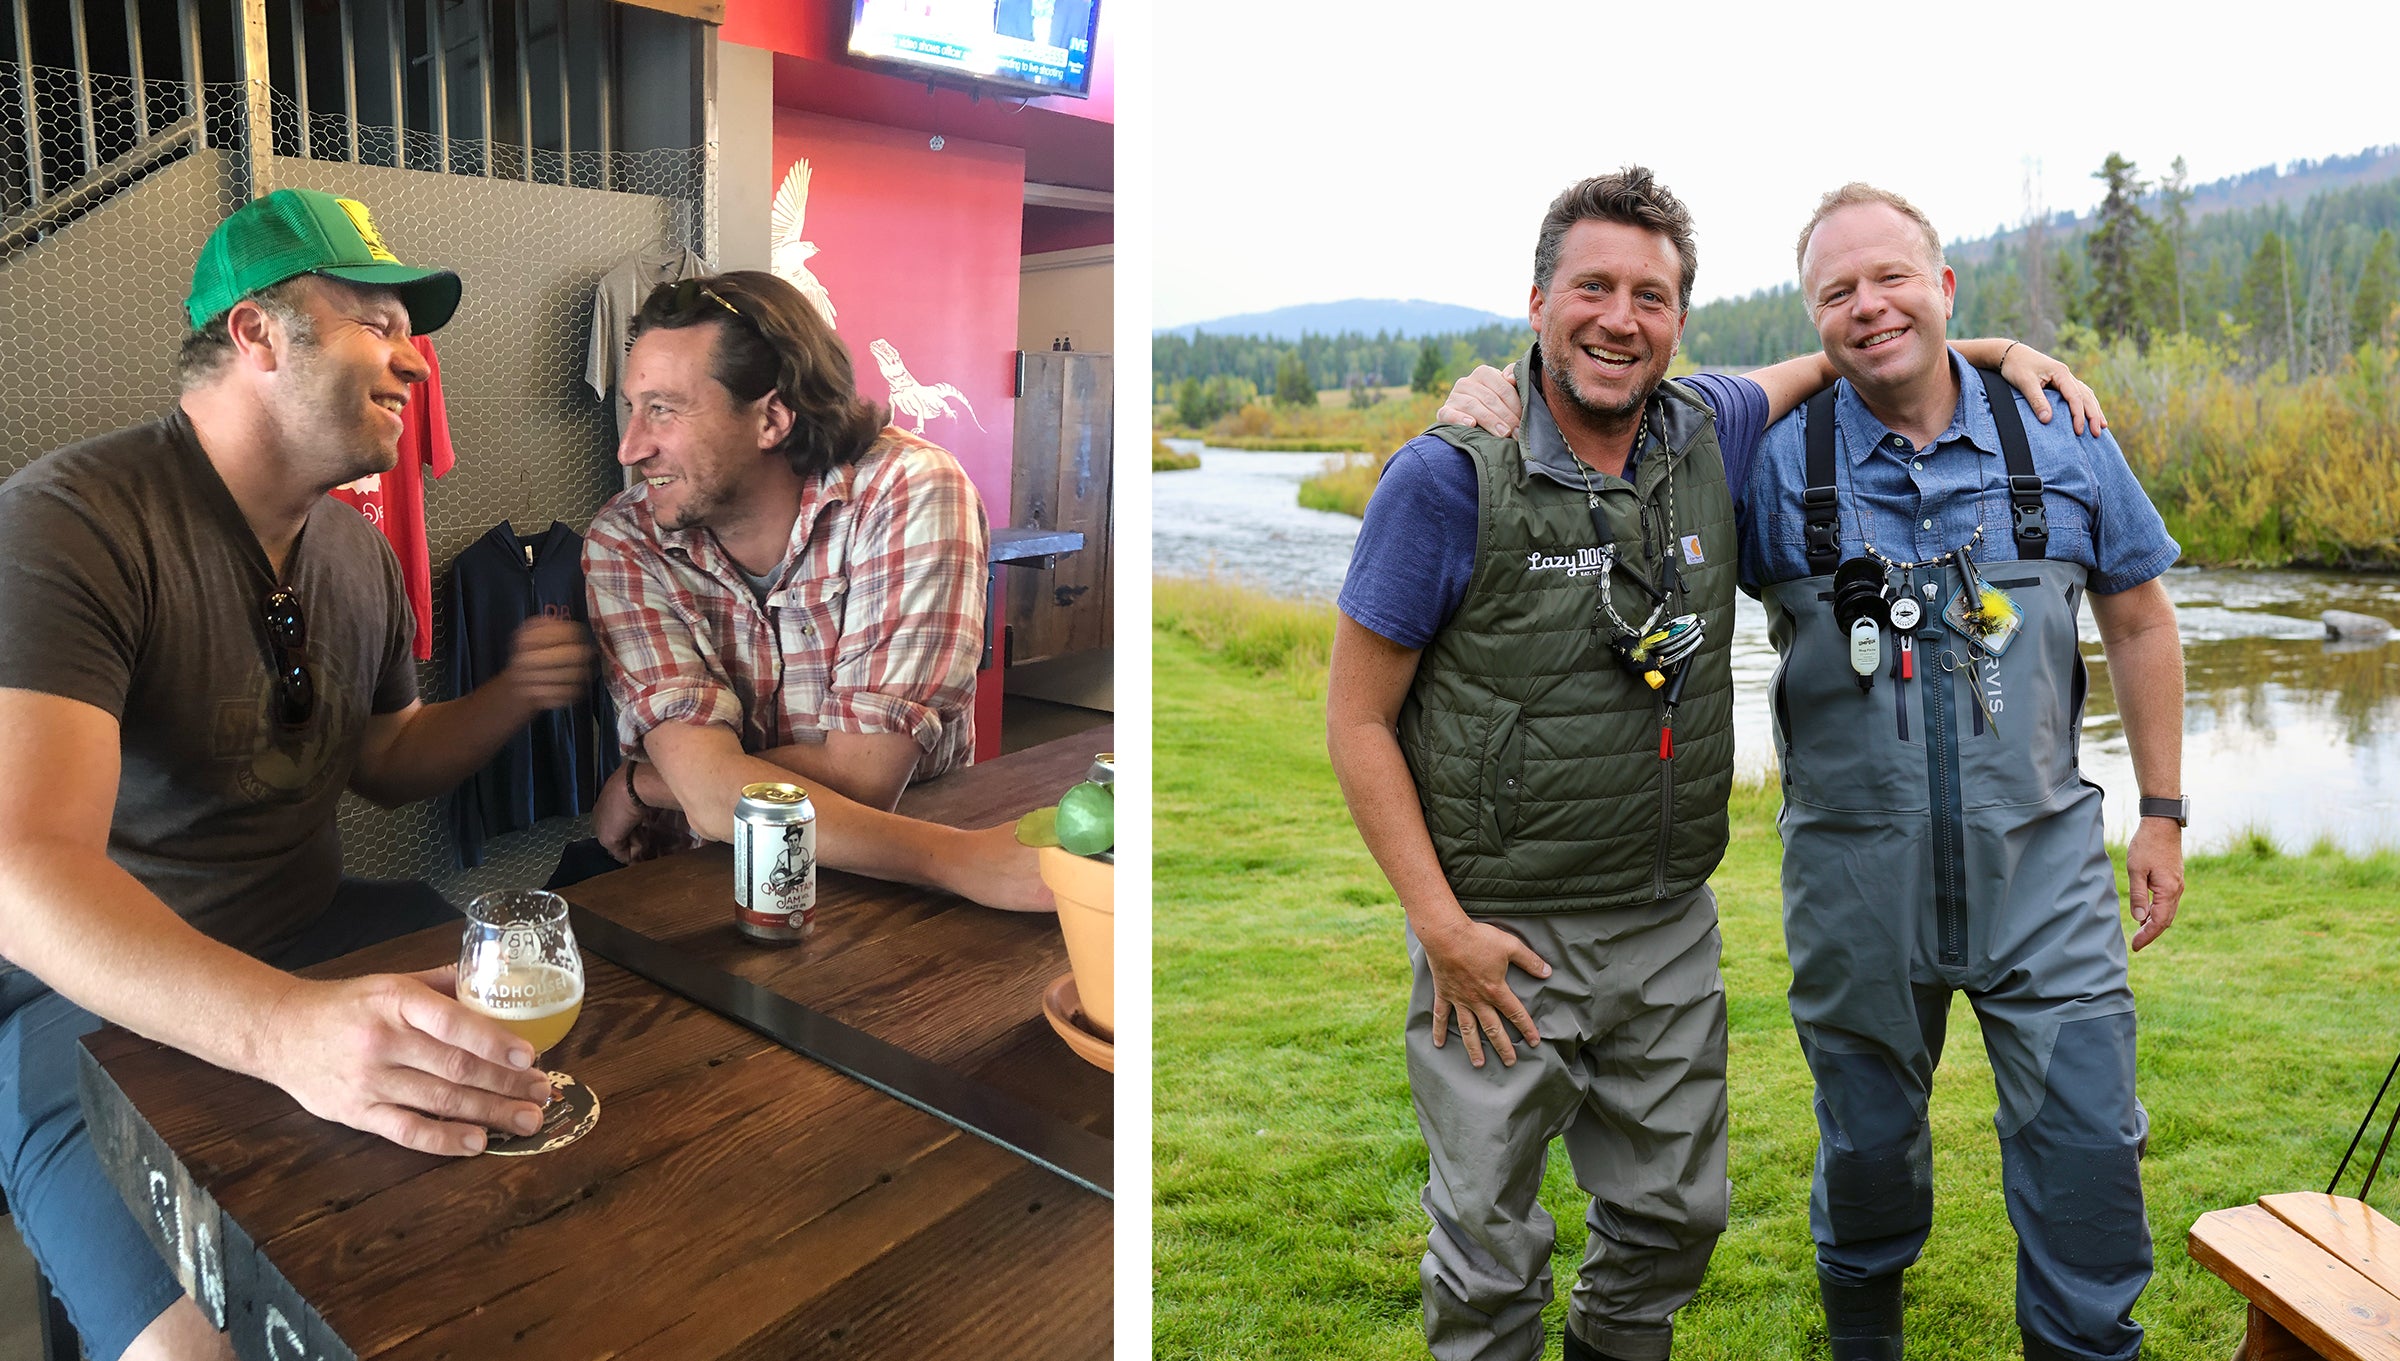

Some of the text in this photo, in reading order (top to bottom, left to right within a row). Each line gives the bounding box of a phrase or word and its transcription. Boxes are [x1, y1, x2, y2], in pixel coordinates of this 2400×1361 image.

[1527, 552, 1576, 577] Lazy
[1984, 655, 2004, 713] RVIS
[761, 881, 814, 896] MNTAIN
[776, 895, 801, 909] JAM
[484, 998, 532, 1008] REWING
